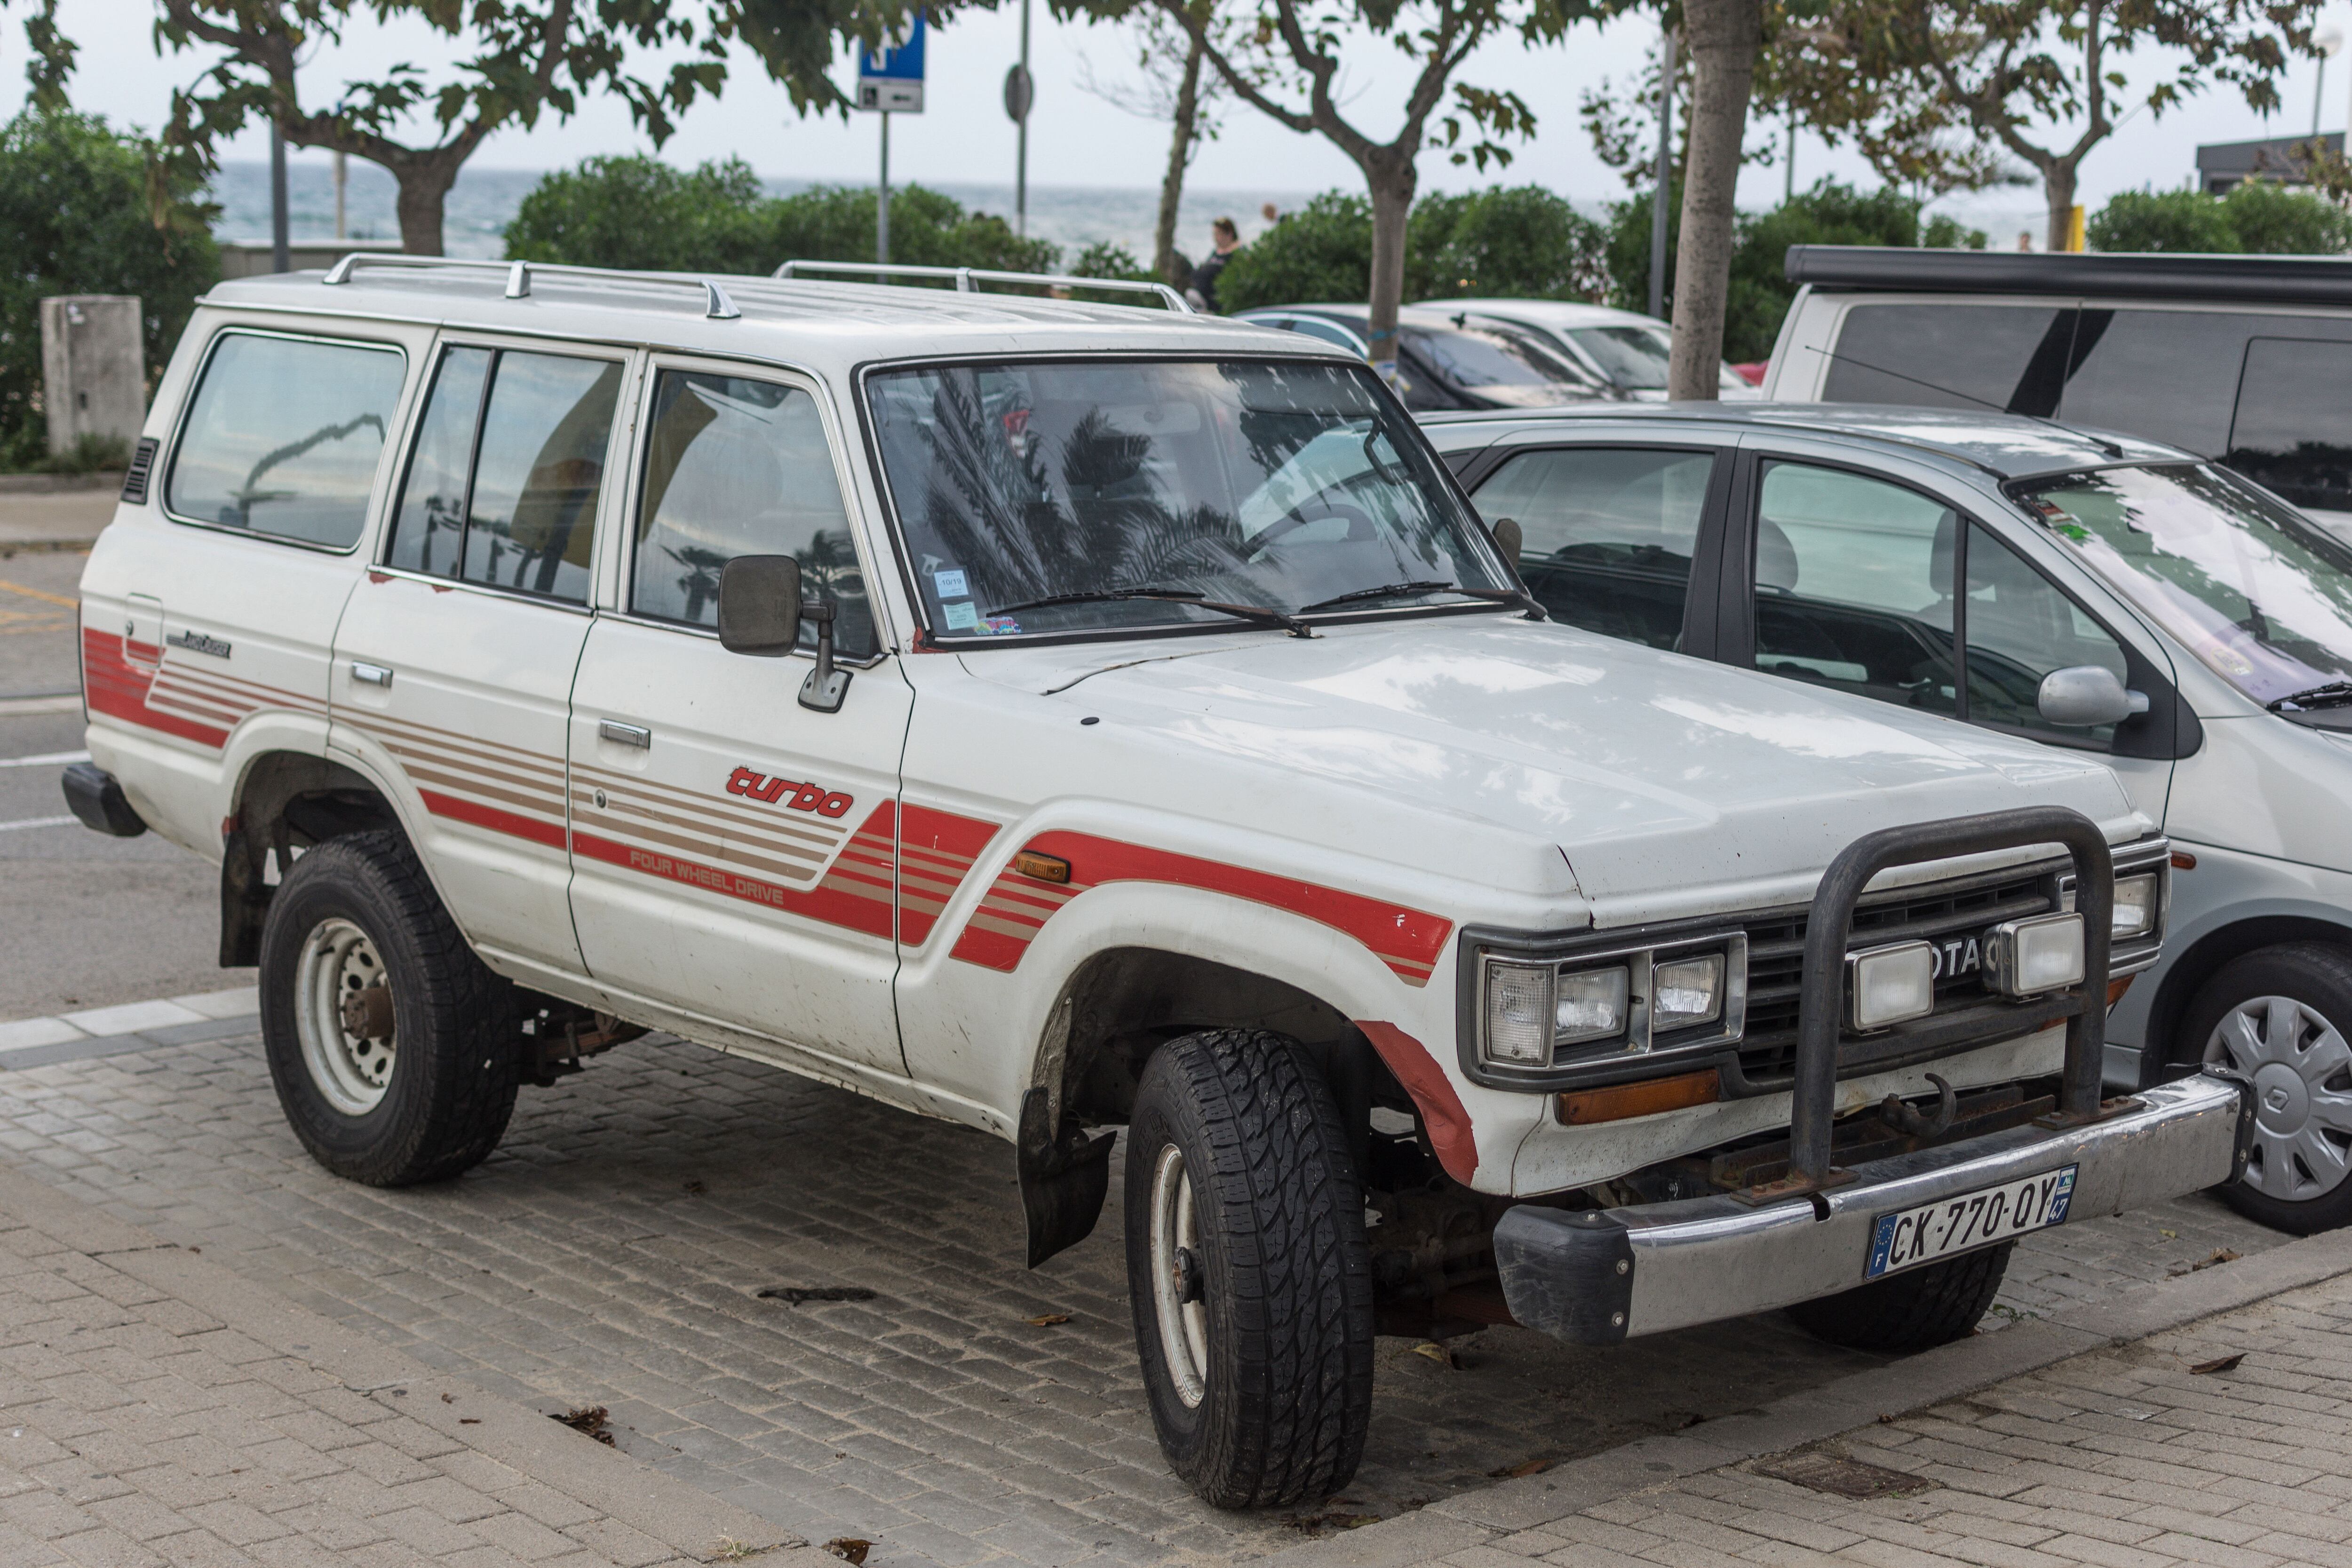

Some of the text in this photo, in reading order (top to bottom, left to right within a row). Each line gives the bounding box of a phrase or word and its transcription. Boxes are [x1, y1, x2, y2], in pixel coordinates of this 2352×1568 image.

[726, 767, 854, 818] turbo
[630, 850, 784, 905] FOUR WHEEL DRIVE
[1890, 1176, 2057, 1265] CK-770-QY
[2049, 1197, 2068, 1220] 47
[1875, 1253, 1883, 1267] F
